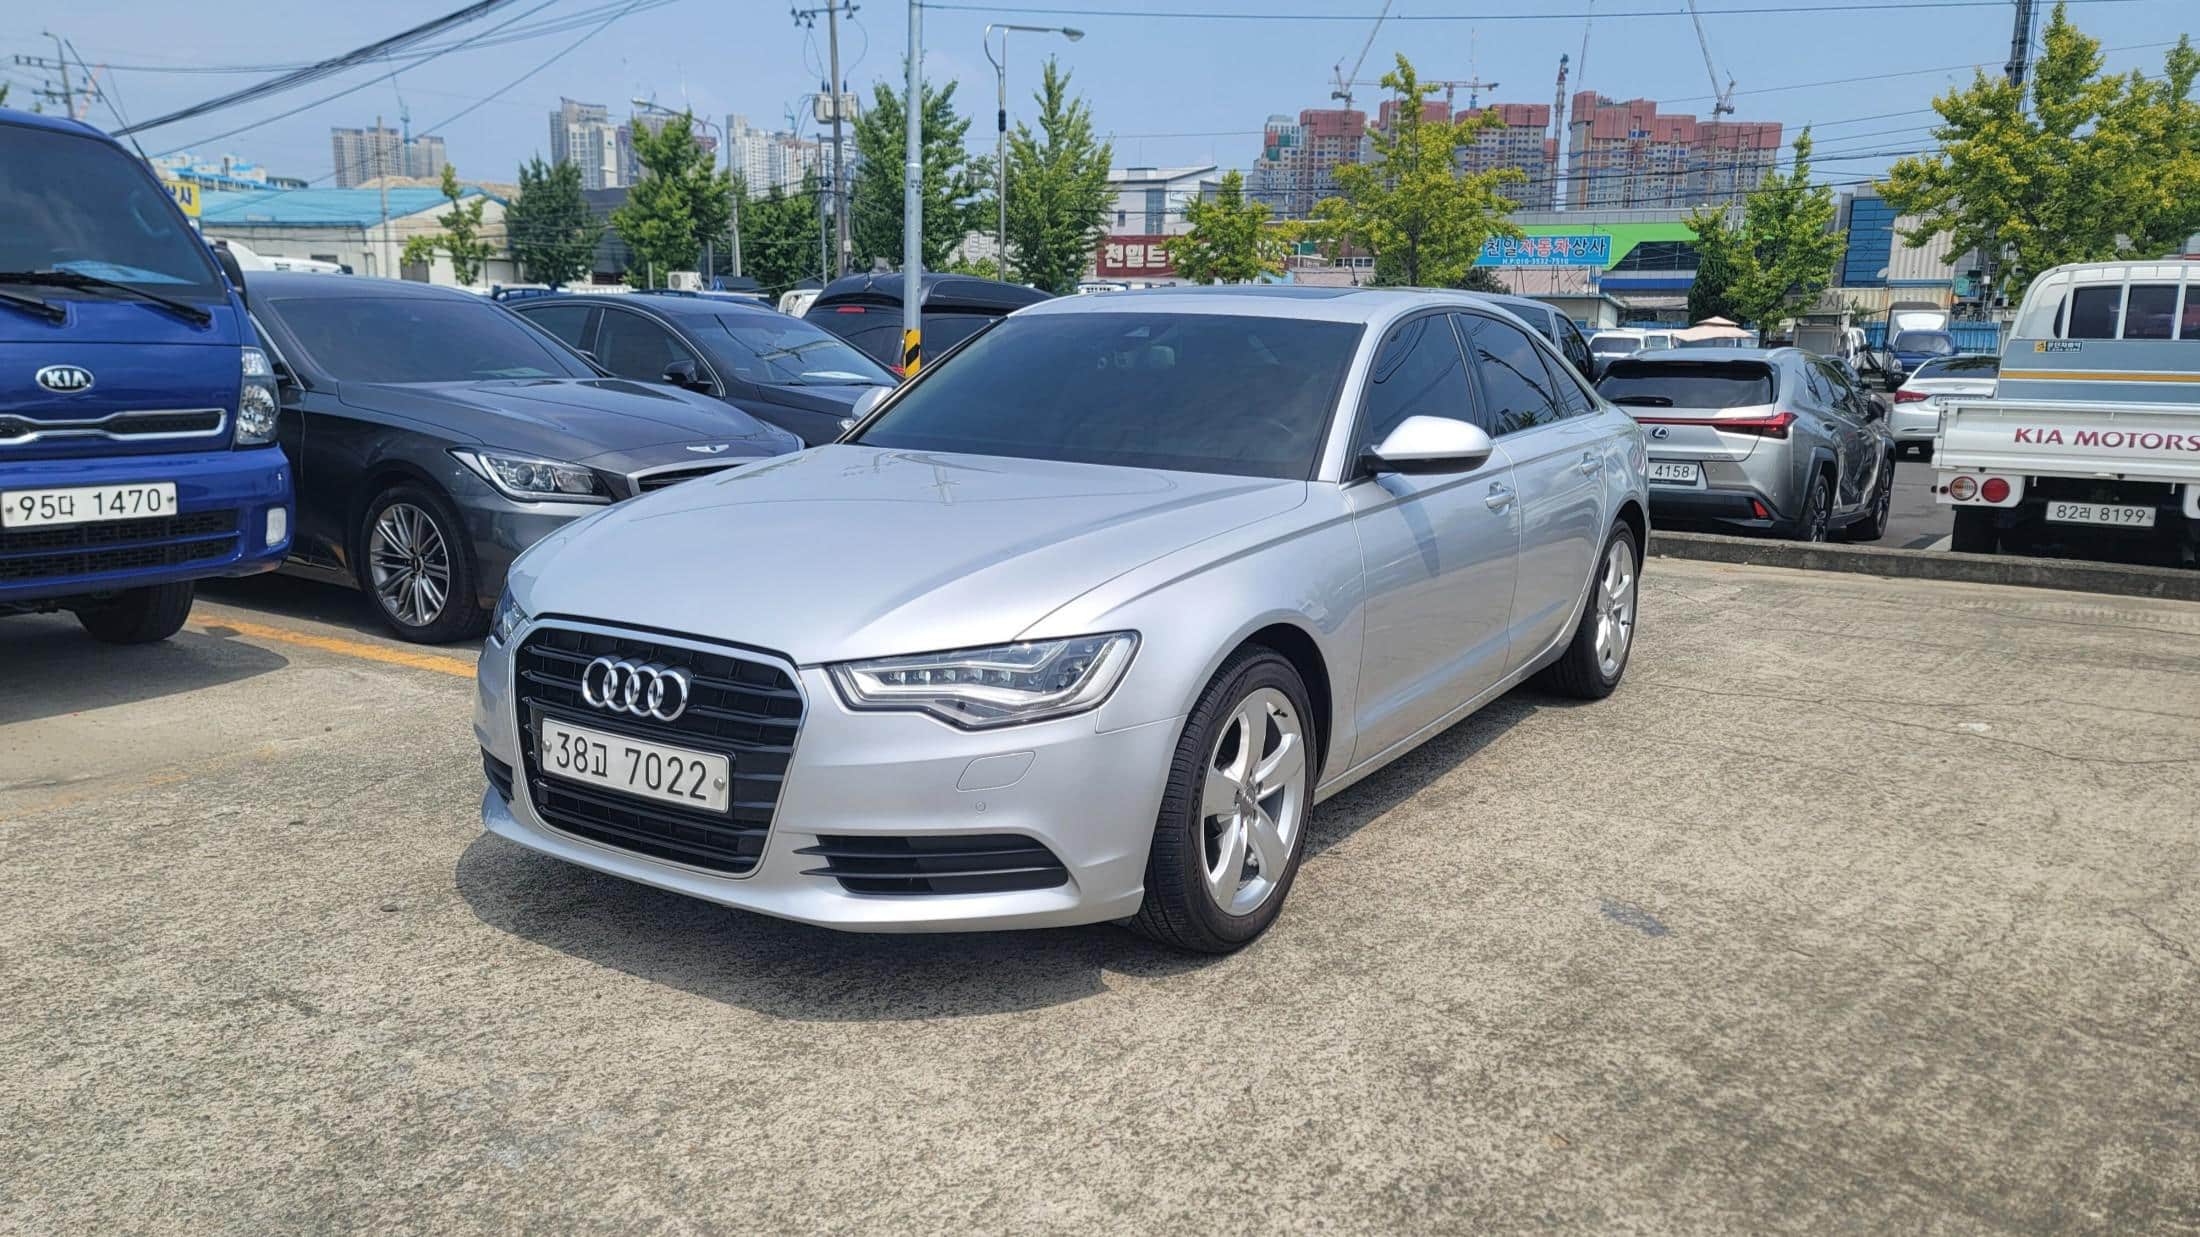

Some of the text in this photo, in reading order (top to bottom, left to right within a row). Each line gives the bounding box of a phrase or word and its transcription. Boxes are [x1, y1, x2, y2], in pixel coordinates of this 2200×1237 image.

[1486, 237, 1606, 258] 천일자동차상사
[46, 370, 88, 387] KIA
[2014, 428, 2200, 452] KIA MOTORS
[1655, 464, 1690, 478] 4158
[19, 488, 162, 521] 95다 1470
[2056, 504, 2146, 523] 82러 8199
[556, 731, 707, 801] 38고 7022
